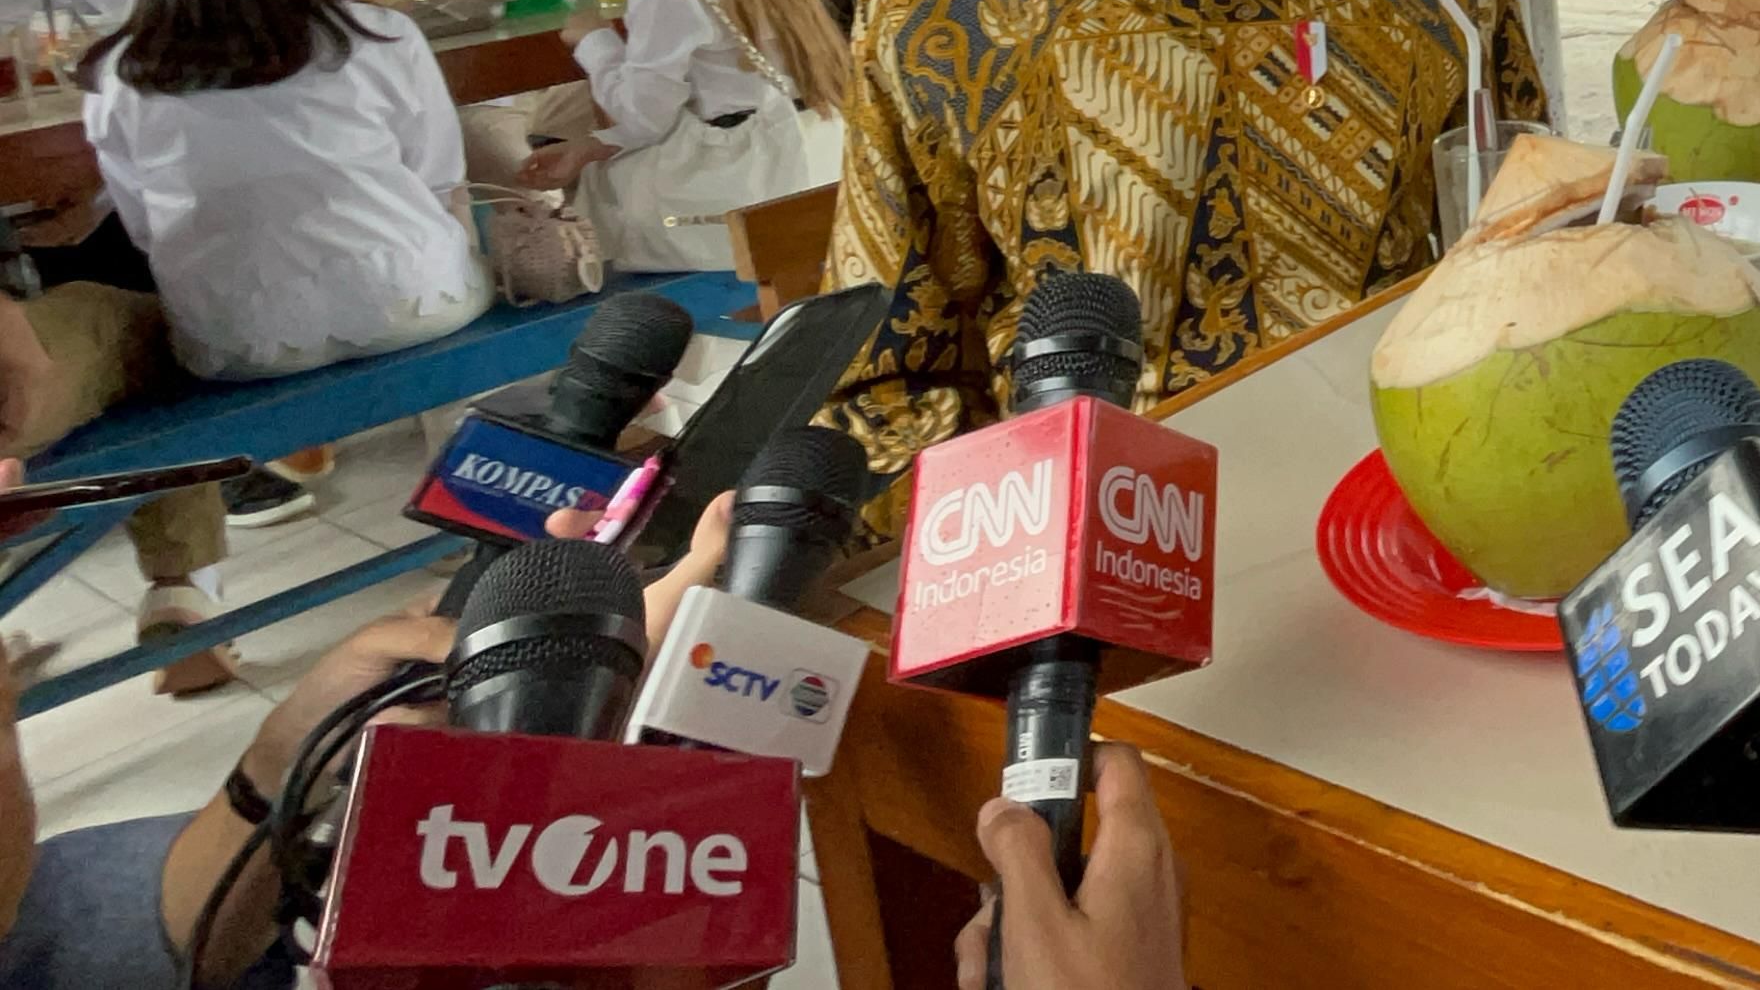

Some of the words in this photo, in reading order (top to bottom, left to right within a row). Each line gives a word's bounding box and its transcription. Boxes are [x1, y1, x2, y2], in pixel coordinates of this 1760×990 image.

[452, 453, 587, 507] KOMPAS
[918, 458, 1054, 566] CNN
[1099, 465, 1205, 562] CNN
[1095, 541, 1202, 601] Indonesia
[704, 661, 781, 702] SCTV
